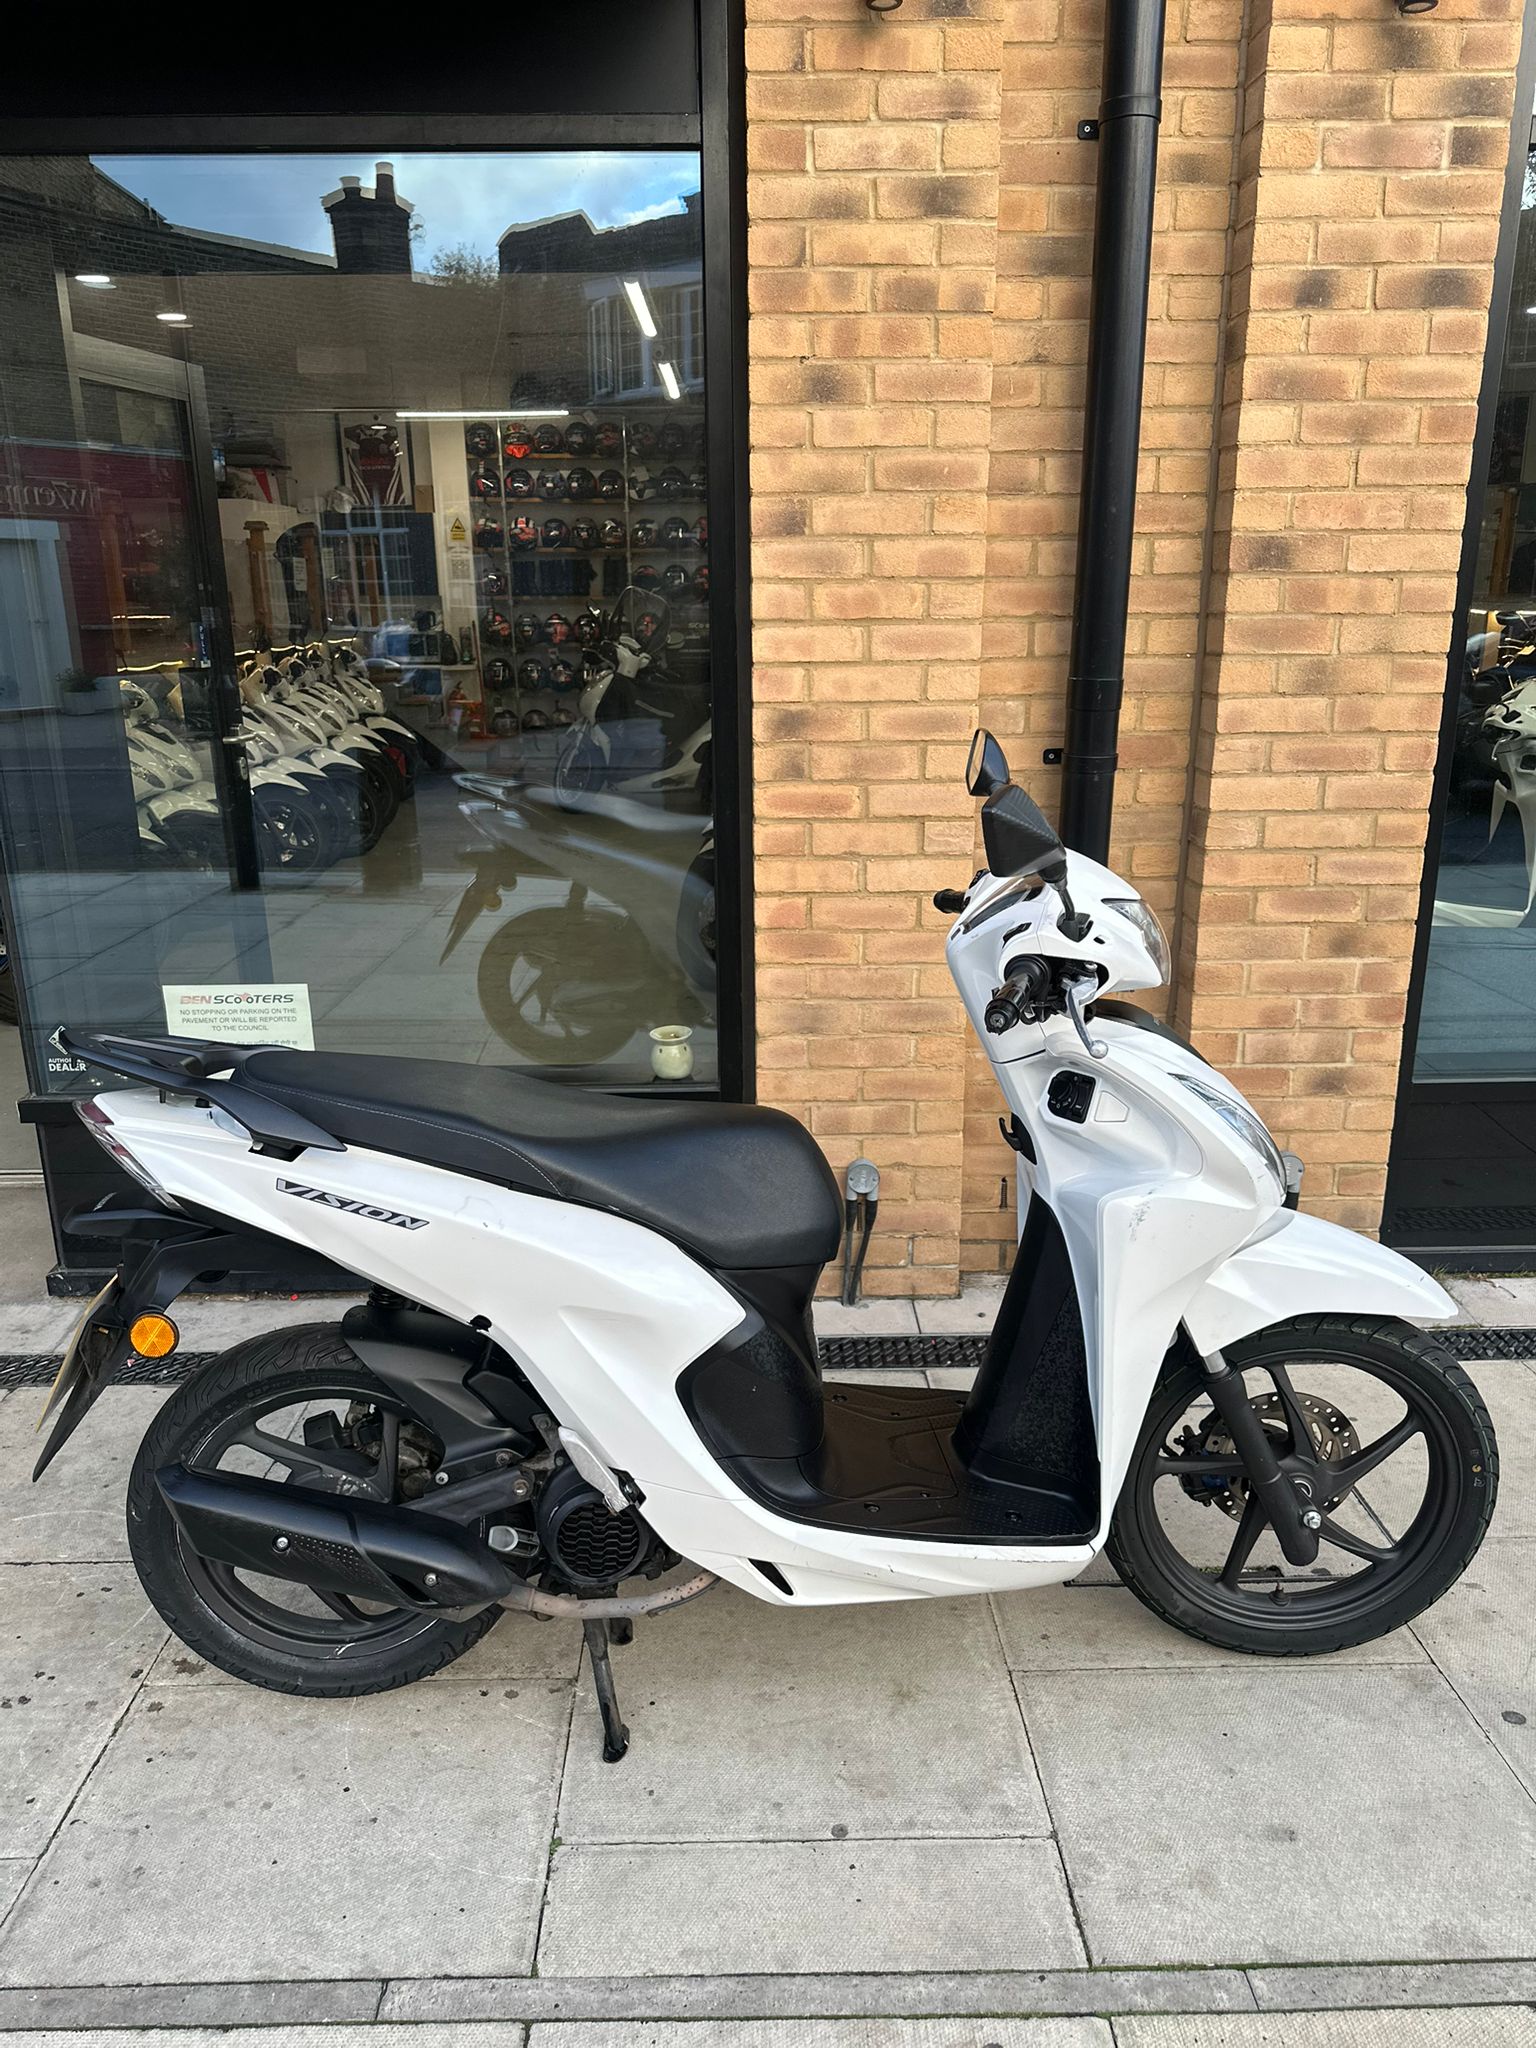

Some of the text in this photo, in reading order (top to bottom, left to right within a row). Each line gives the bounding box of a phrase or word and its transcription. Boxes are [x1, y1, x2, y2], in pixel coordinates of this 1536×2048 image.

[180, 995, 212, 1004] BEN
[259, 1015, 297, 1023] REPORTED
[276, 1178, 429, 1230] VISION
